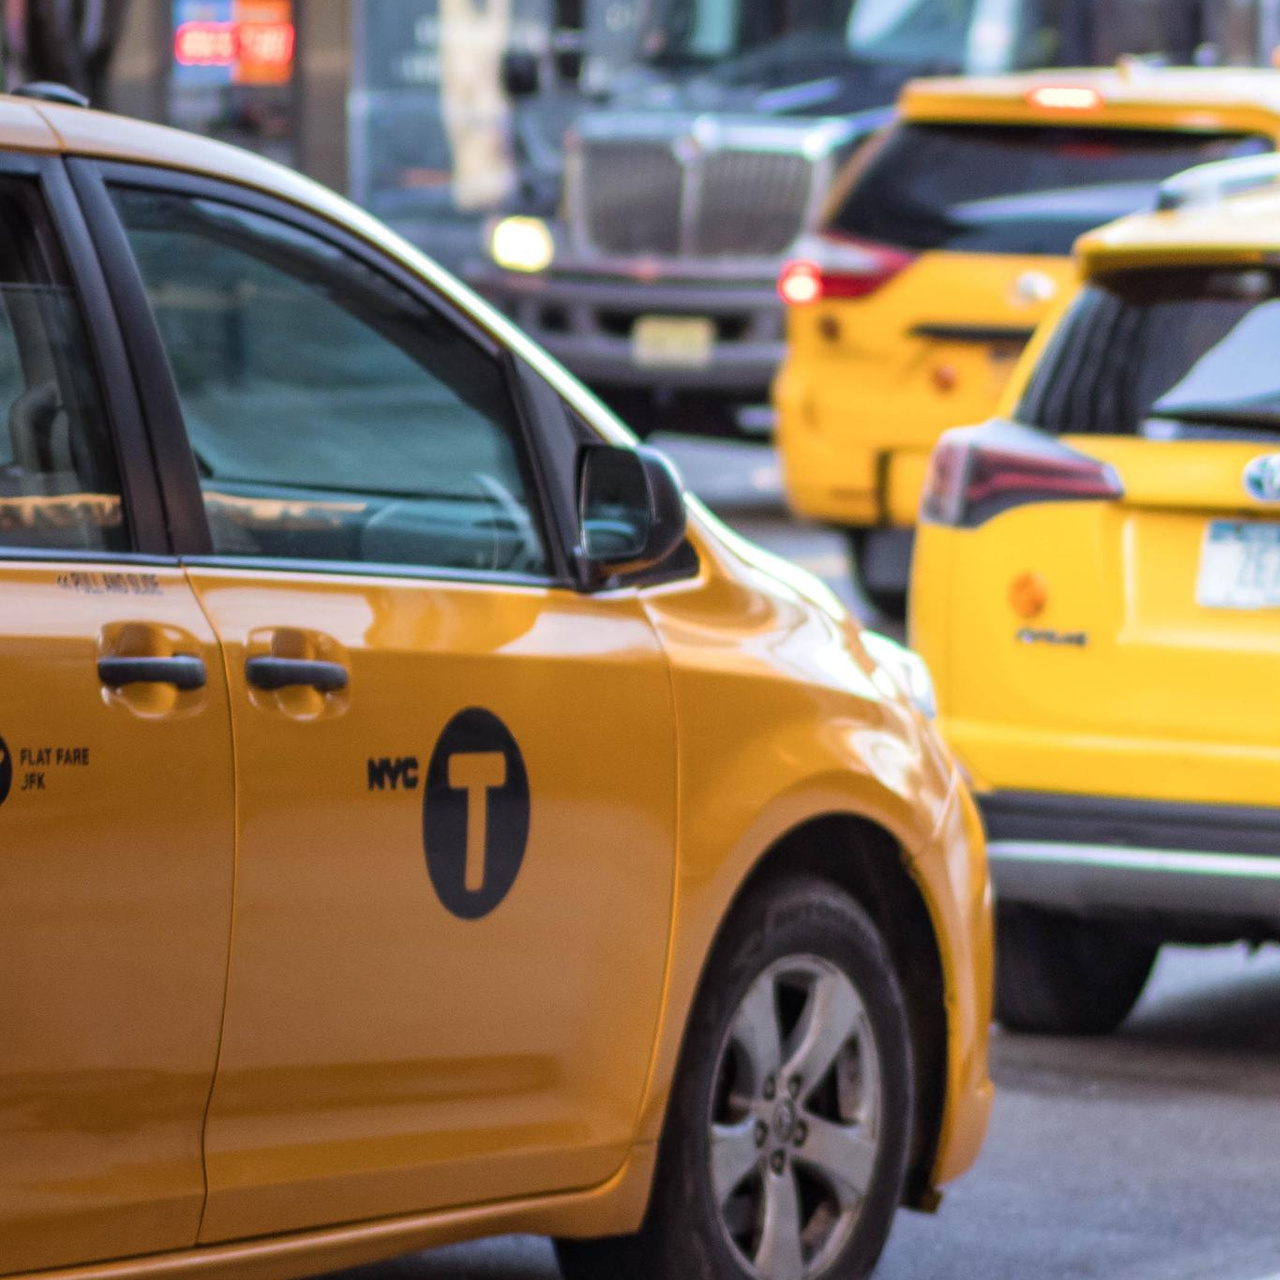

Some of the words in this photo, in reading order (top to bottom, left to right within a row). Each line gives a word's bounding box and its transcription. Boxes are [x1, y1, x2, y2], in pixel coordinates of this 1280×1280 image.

[20, 747, 52, 766] FLAT
[56, 747, 90, 767] FARE
[21, 771, 46, 790] JFK
[367, 757, 418, 790] NYC
[449, 751, 506, 892] T
